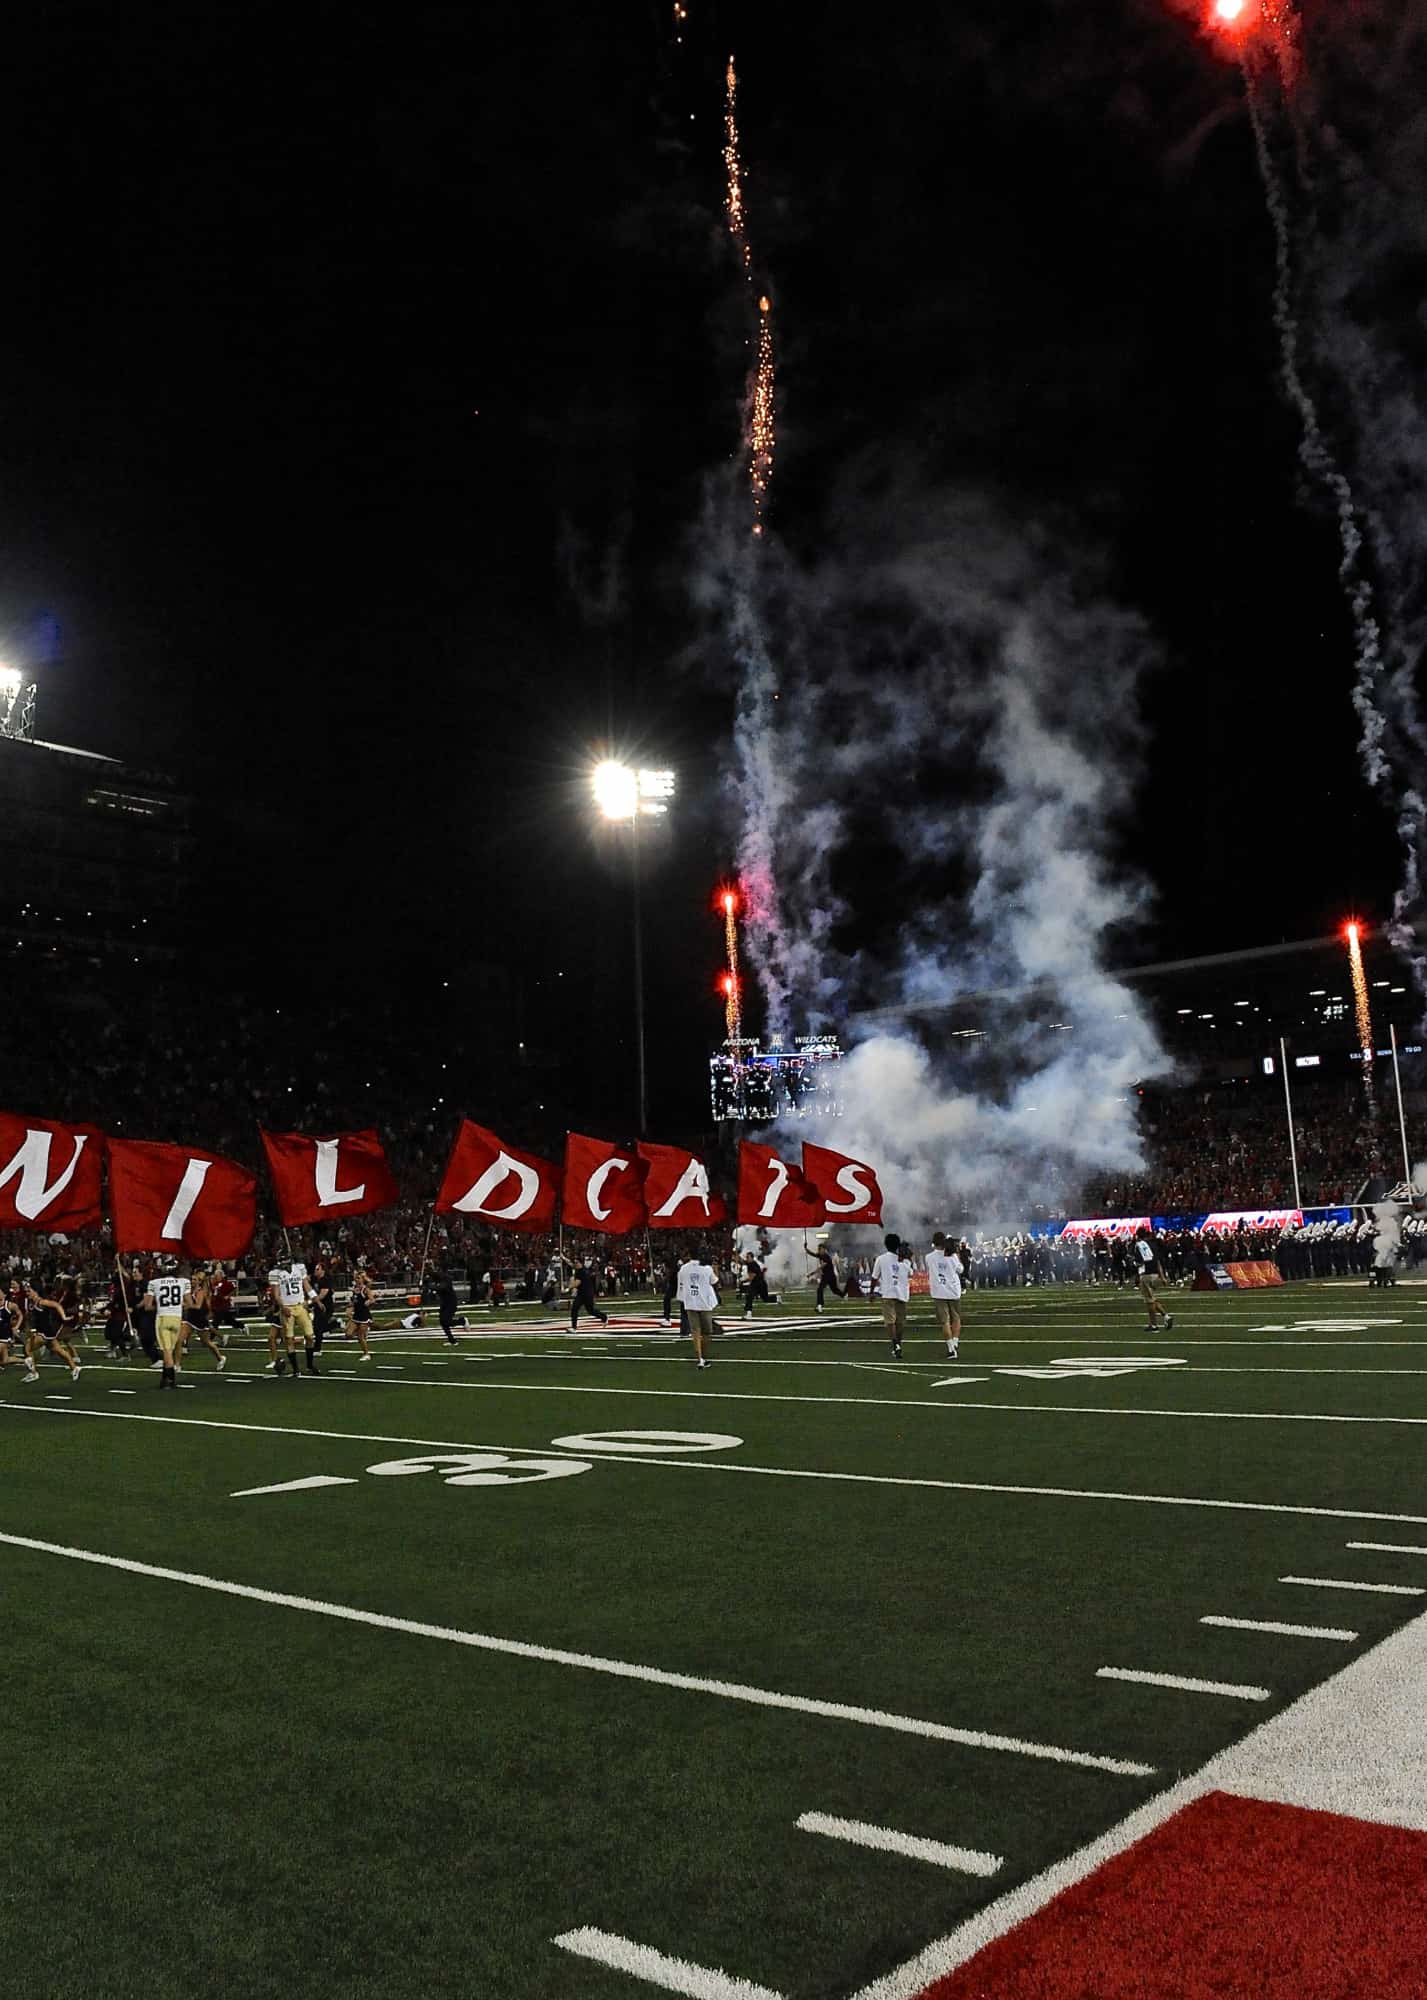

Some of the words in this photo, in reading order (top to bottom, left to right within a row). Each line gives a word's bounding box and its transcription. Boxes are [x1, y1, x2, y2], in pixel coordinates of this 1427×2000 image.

[722, 1037, 760, 1047] ARIZONA
[794, 1035, 838, 1044] WILDCATS
[161, 1158, 213, 1240] I
[315, 1138, 365, 1207] L
[452, 1150, 539, 1220] D
[587, 1158, 629, 1221] C
[653, 1158, 711, 1216] A
[825, 1164, 871, 1213] S
[160, 1285, 181, 1307] 28
[286, 1282, 300, 1296] 15
